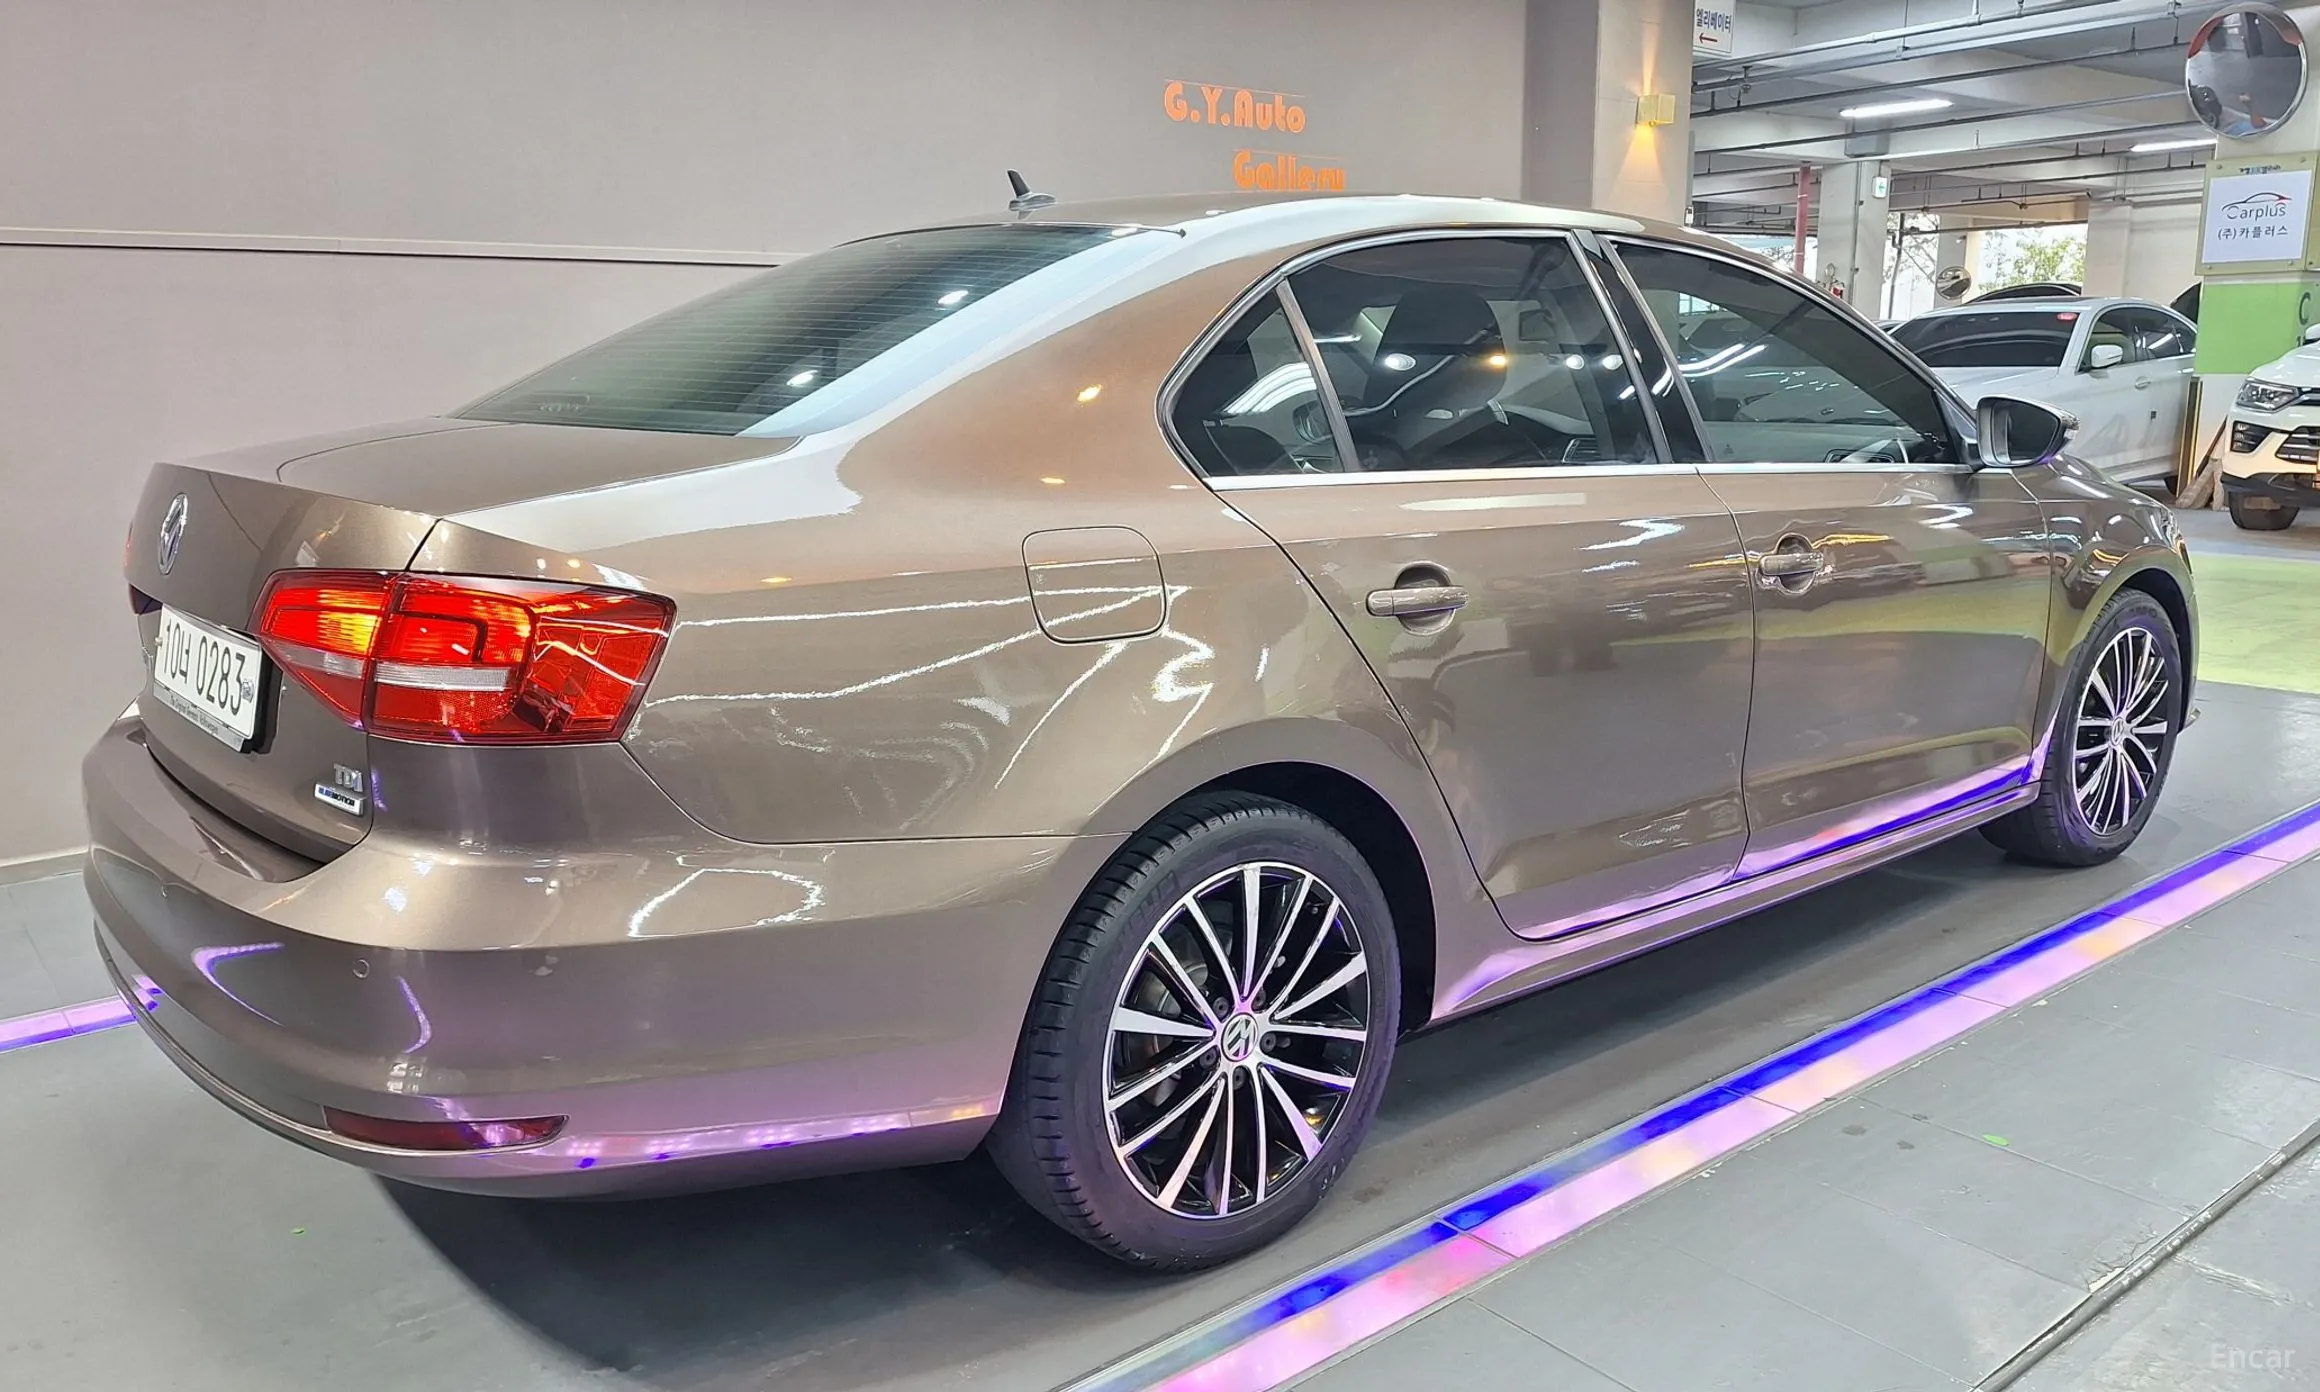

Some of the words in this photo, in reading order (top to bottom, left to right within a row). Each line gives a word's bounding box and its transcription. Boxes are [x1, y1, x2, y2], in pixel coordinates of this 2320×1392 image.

[1696, 8, 1731, 33] 엘리베이터
[1164, 81, 1306, 133] G.Y.Auto
[2226, 203, 2287, 220] Carplus
[196, 635, 246, 715] 0283
[333, 762, 364, 793] TDI
